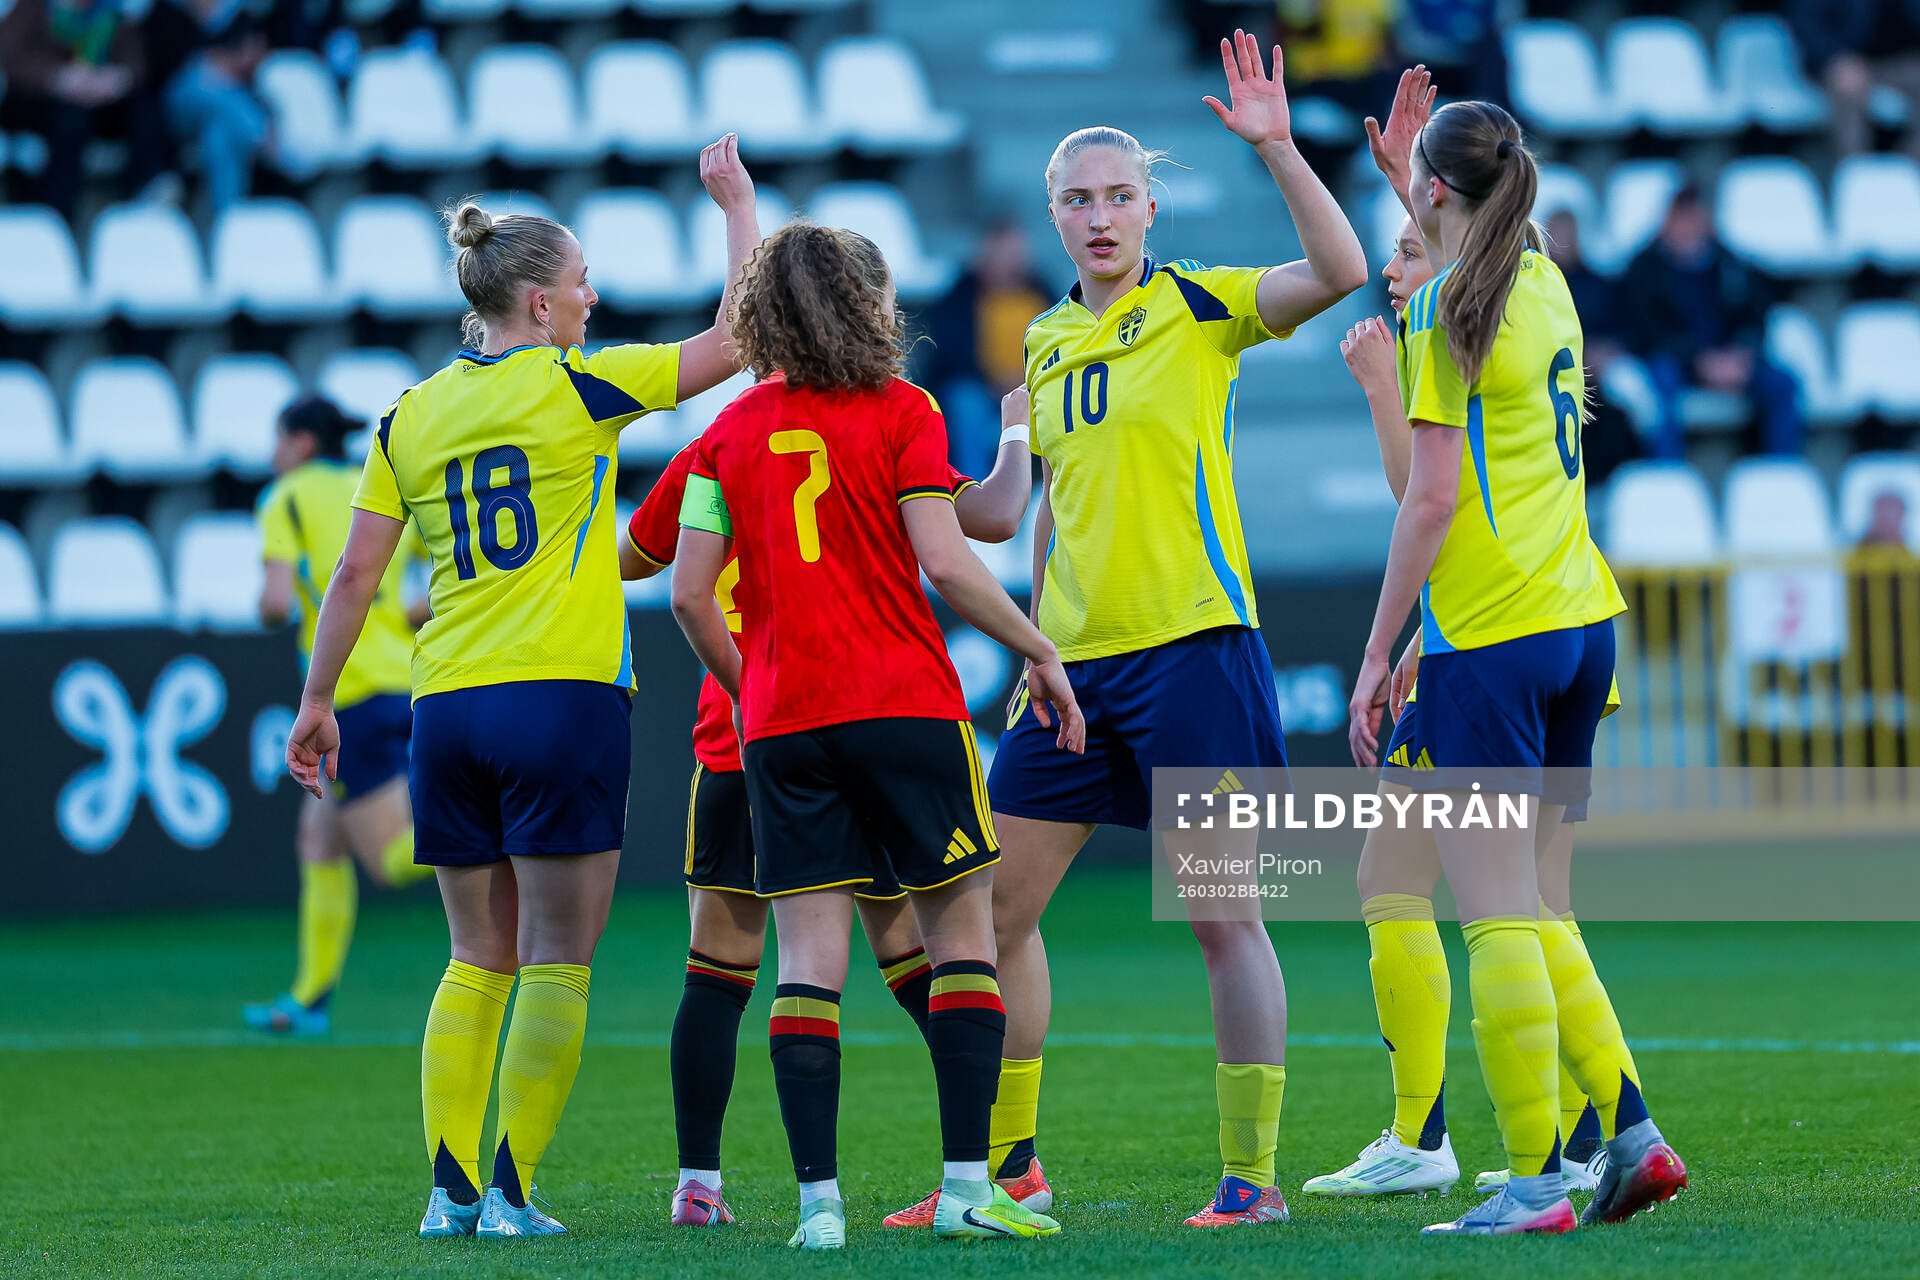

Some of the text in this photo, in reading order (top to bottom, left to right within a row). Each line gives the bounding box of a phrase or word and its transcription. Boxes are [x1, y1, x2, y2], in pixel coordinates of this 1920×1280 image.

[1063, 361, 1109, 434] 10
[1547, 347, 1579, 480] 6
[445, 444, 539, 581] 18
[768, 429, 831, 563] 7
